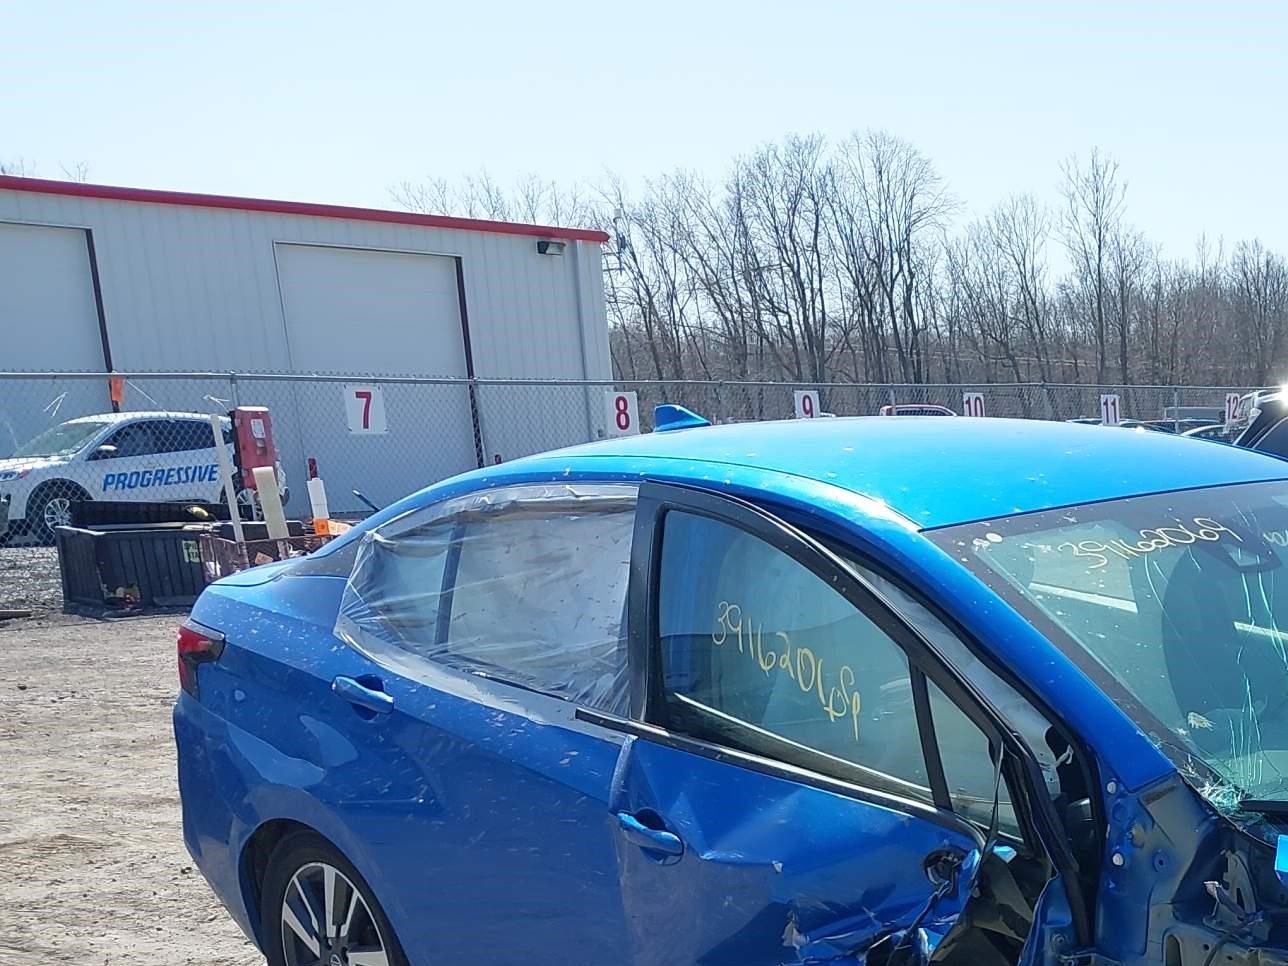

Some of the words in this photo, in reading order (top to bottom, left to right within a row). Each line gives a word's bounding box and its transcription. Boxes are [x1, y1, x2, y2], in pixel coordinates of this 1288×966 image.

[354, 391, 373, 430] 7
[614, 395, 631, 431] 8
[802, 394, 814, 418] 9
[965, 395, 986, 418] 10
[1102, 398, 1119, 424] 11
[1227, 396, 1239, 420] 12
[102, 463, 220, 492] PROGRESSIVE
